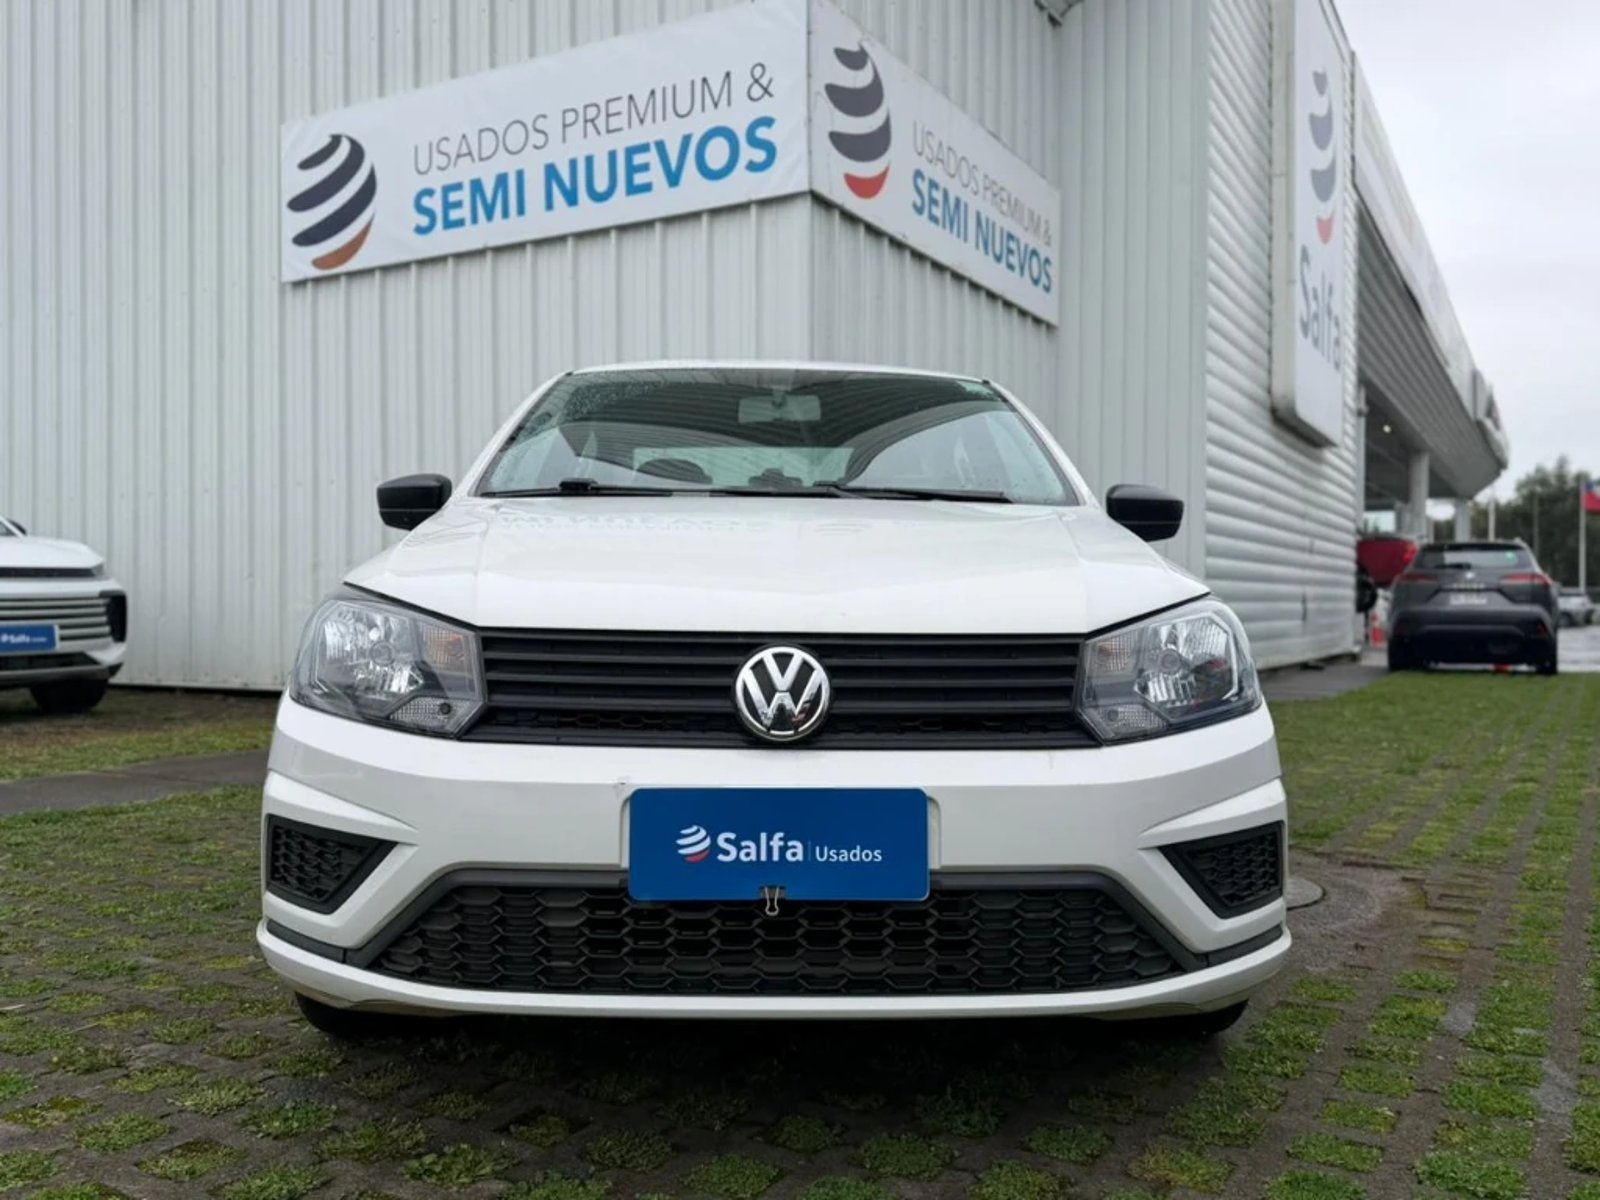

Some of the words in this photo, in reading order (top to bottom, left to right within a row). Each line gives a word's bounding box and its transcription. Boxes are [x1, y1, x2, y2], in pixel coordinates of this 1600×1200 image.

[413, 114, 549, 176] USADOS
[561, 70, 732, 144] PREMIUM
[746, 62, 774, 102] &
[413, 168, 526, 236] SEMI
[543, 116, 778, 212] NUEVOS
[912, 120, 980, 197] USADOS
[983, 172, 1042, 240] PREMIUM
[912, 168, 968, 244] SEMI
[975, 209, 1053, 294] NUEVOS
[1299, 243, 1341, 373] Salfa
[716, 832, 804, 862] Salfa
[815, 845, 882, 862] Usados
